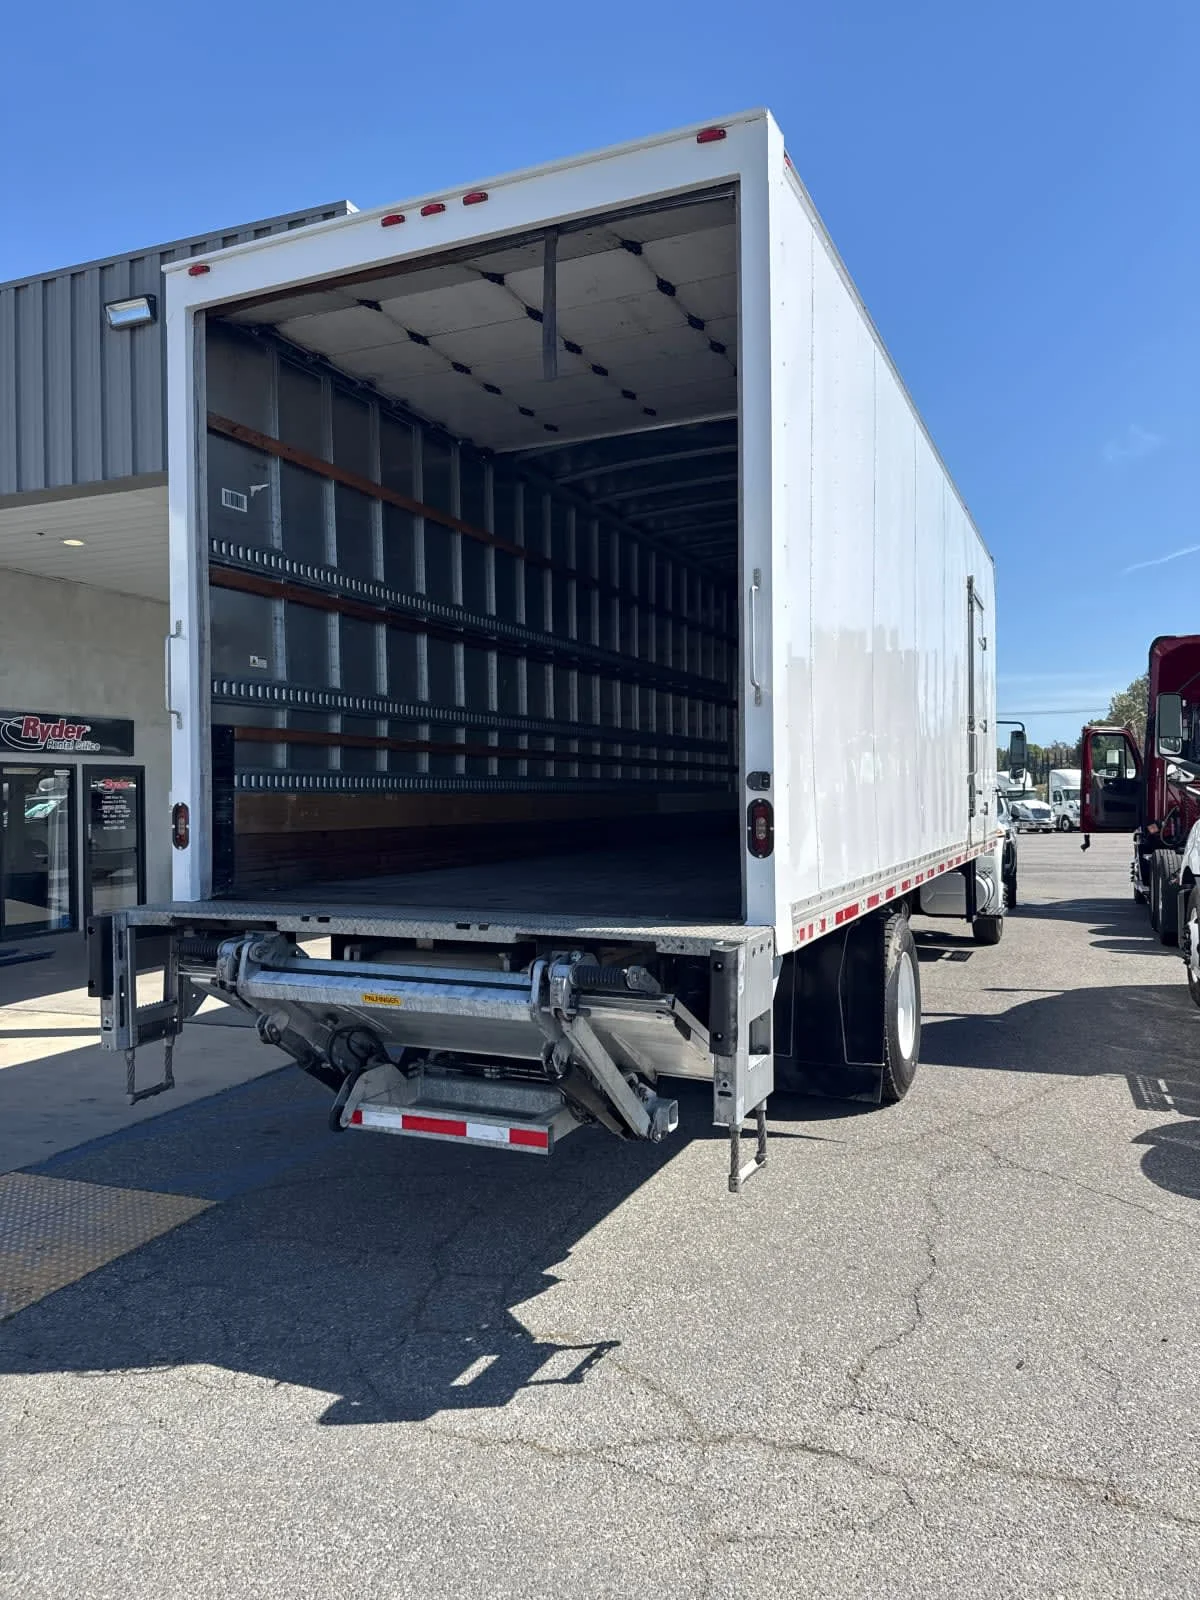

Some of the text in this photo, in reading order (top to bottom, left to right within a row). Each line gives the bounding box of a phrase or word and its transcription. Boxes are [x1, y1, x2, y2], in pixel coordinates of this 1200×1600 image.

[21, 715, 88, 743] Ryder
[46, 738, 101, 751] Rental Office
